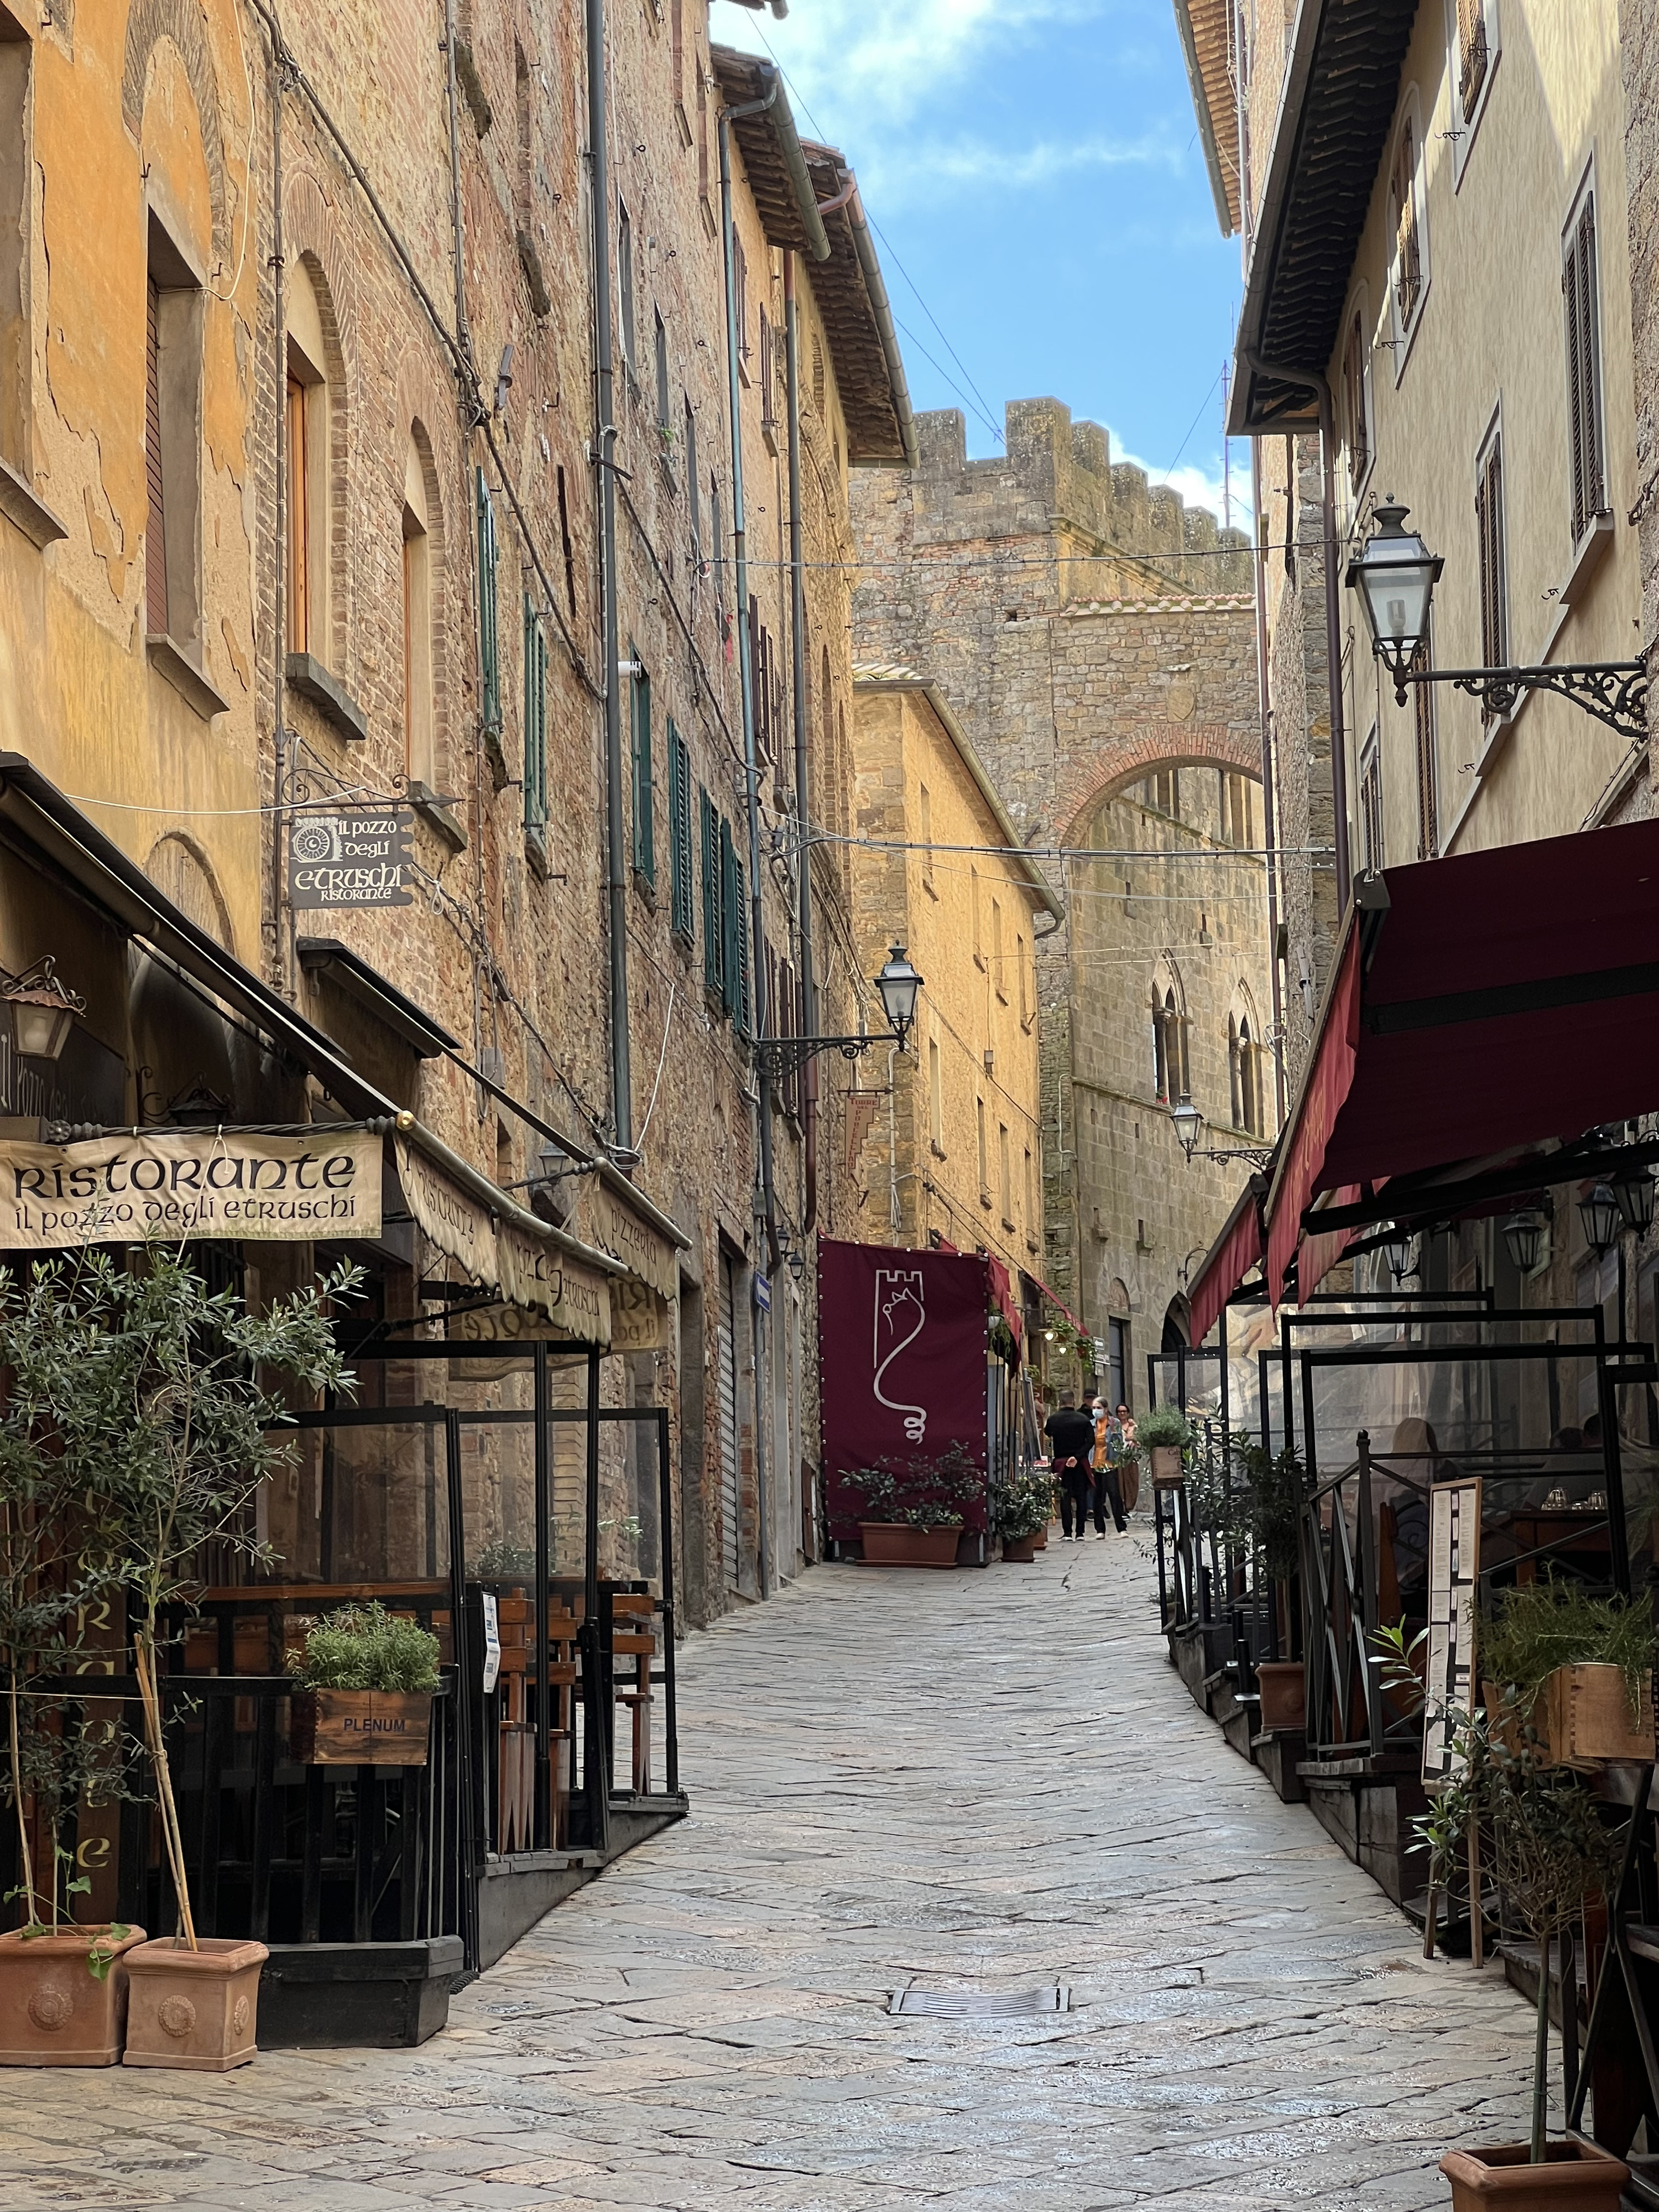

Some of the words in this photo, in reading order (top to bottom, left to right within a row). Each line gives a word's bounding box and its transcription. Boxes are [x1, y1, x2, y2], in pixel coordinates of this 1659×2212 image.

[352, 821, 397, 838] pozzo
[13, 1152, 356, 1199] Ristorante
[143, 1196, 215, 1228] degli
[223, 1194, 356, 1219] etruschi
[611, 1206, 657, 1267] pizzeria
[343, 1718, 406, 1732] PLENUM
